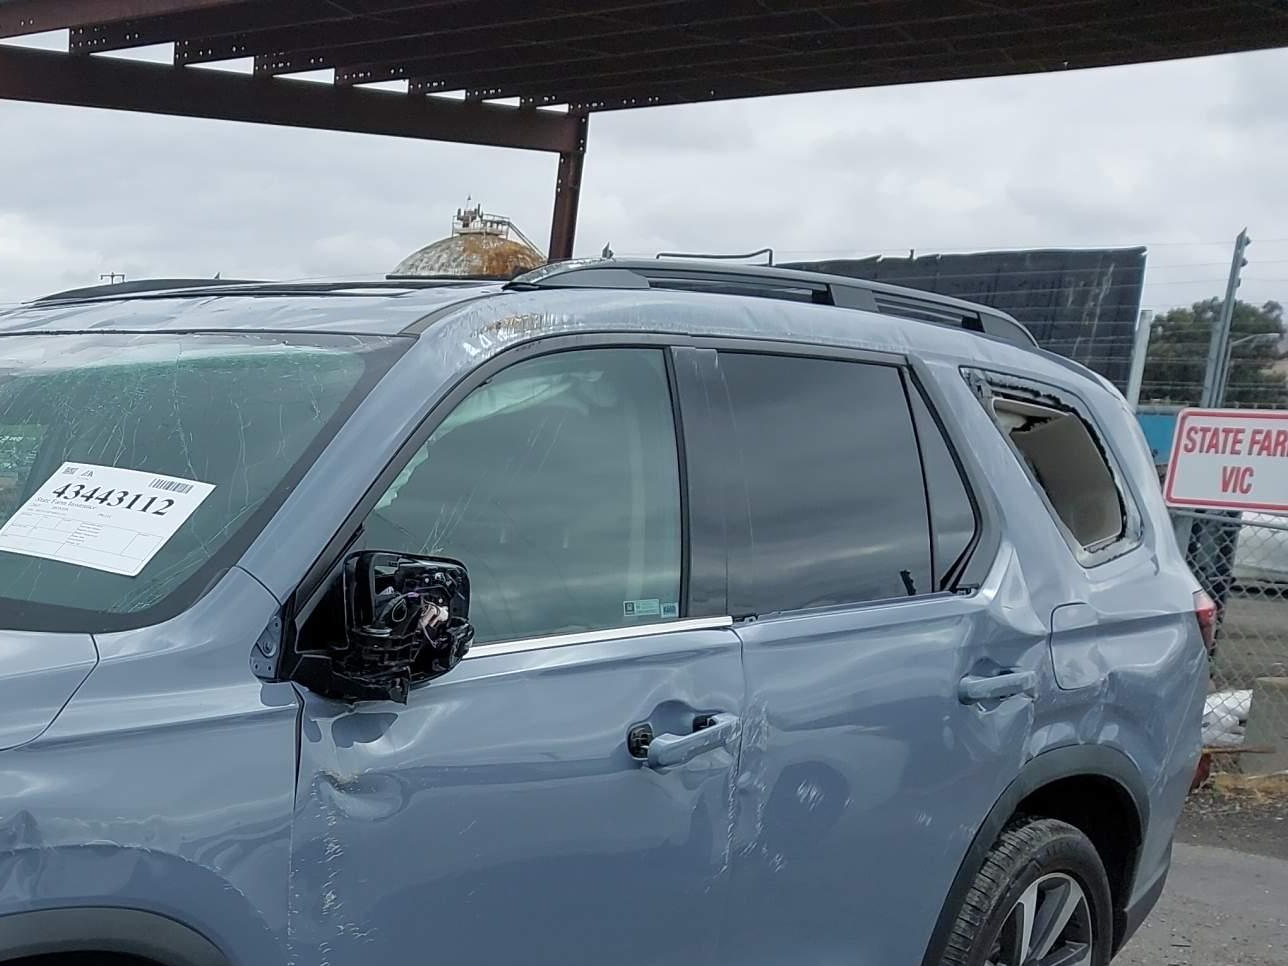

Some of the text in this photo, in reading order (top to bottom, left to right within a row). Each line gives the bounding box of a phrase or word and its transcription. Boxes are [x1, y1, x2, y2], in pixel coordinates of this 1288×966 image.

[1183, 426, 1288, 457] STATE FAR
[1221, 465, 1254, 494] VIC
[52, 483, 174, 516] 43443112
